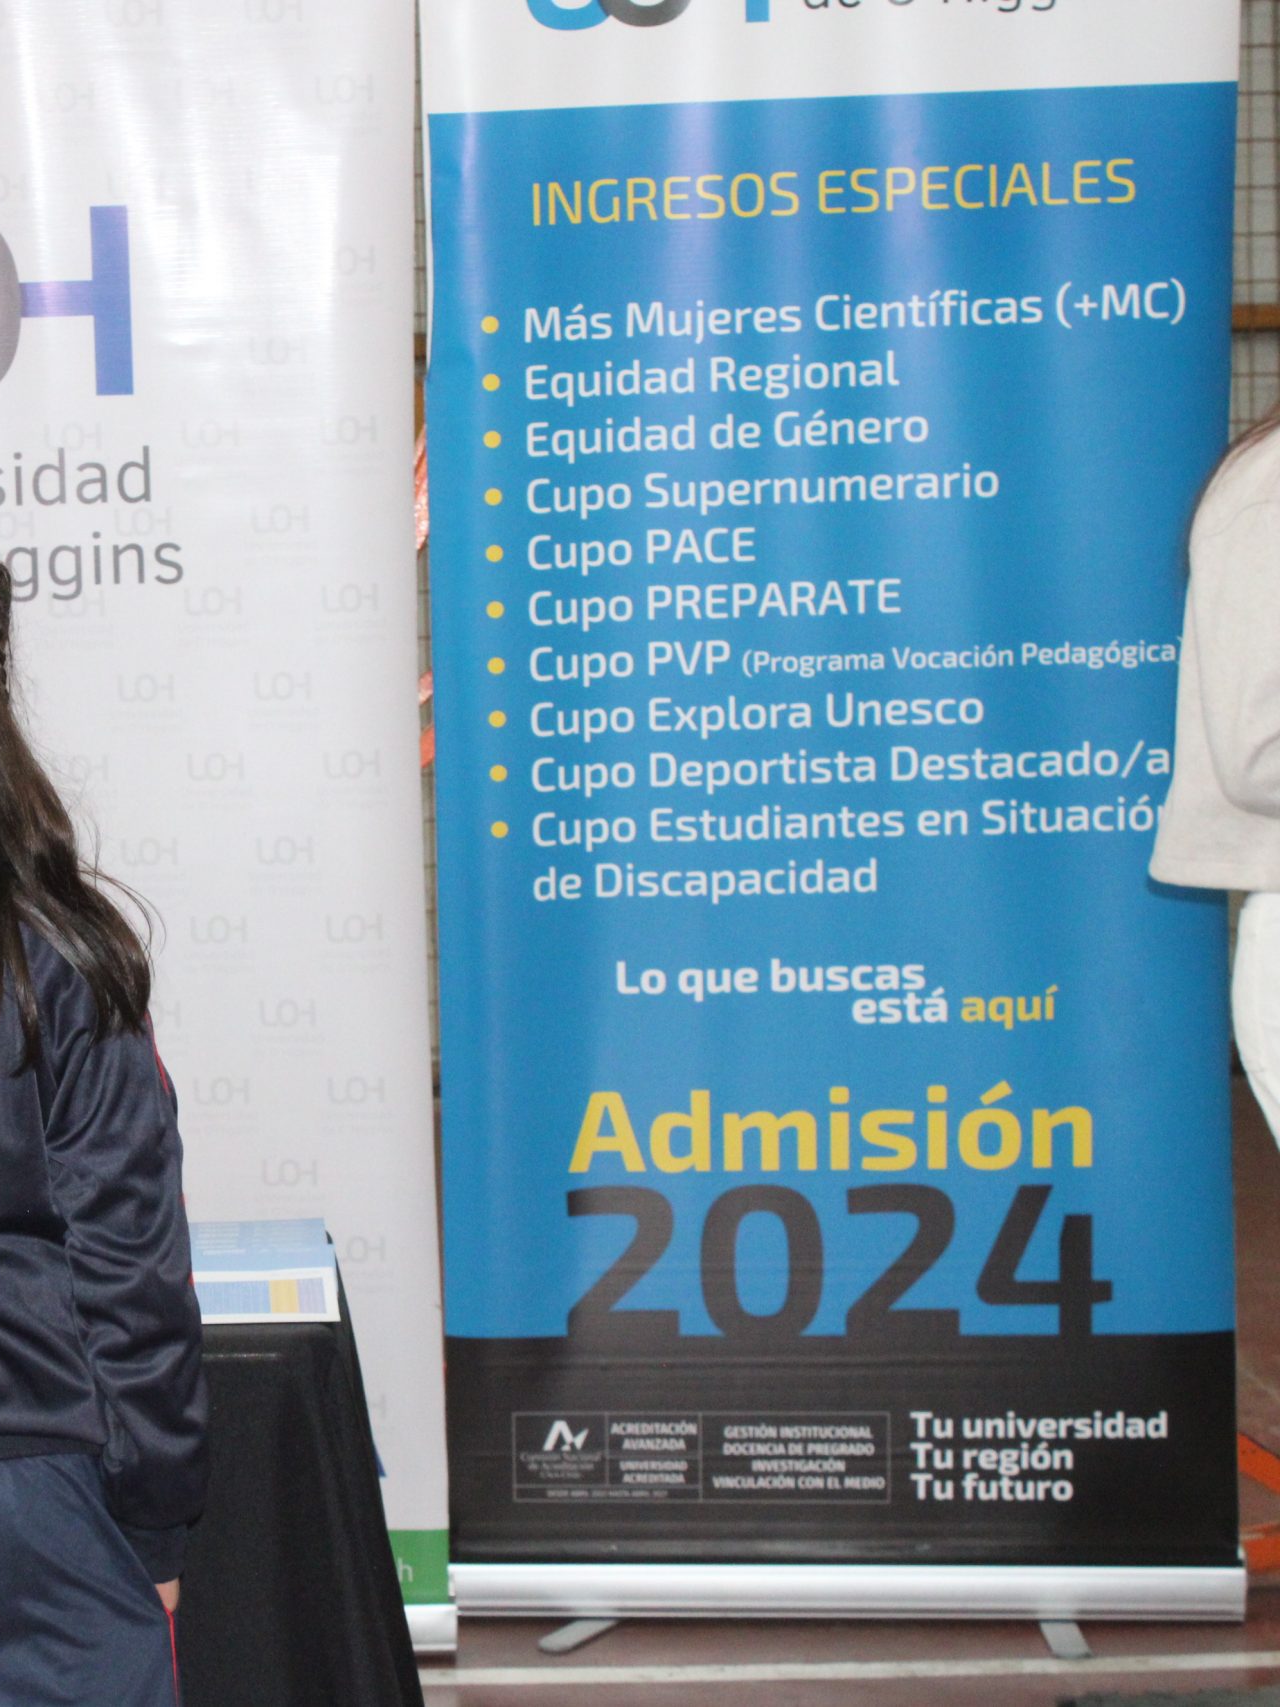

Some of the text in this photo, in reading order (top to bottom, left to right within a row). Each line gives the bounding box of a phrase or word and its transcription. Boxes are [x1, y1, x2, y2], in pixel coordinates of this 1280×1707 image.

[532, 158, 1136, 226] INGRESOS ESPECIALES
[524, 277, 1186, 345] Más Mujeres Científicas (+MC)
[525, 350, 901, 407] Equidad Regional
[526, 409, 930, 464] Equidad de Género
[527, 462, 999, 520] Cupo Supernumerario
[527, 527, 756, 577] Cupo PACE
[528, 578, 902, 632] Cupo PREPARATE
[529, 639, 1180, 688] Cupo PVP (Programa Vocación Pedagógica
[530, 692, 984, 743] Cupo Explora Unesco
[531, 740, 1170, 798] Cupo Deportista Destacado/a
[532, 811, 638, 853] Cupo
[650, 805, 905, 842] Estudiantes
[917, 809, 969, 837] en
[533, 858, 878, 905] de Discapacidad
[616, 958, 926, 1003] Lo que buscas
[852, 984, 1058, 1030] está aquí
[568, 1080, 1093, 1174] Admisión
[566, 1183, 1113, 1336] 2024
[610, 1420, 698, 1436] ACREDITACIÓN
[622, 1437, 686, 1451] AVANZADA
[722, 1442, 875, 1456] DOCENCIA DE PREGRADO
[723, 1422, 873, 1439] GESTIÓN INSTITUCIONAL
[909, 1410, 1168, 1440] Tu universidad
[712, 1474, 886, 1490] VINCULACIÓN CON EL MEDIO
[751, 1457, 846, 1473] INVESTIGACIÓN
[909, 1441, 1074, 1480] Tu región
[910, 1471, 1074, 1501] Tu futuro
